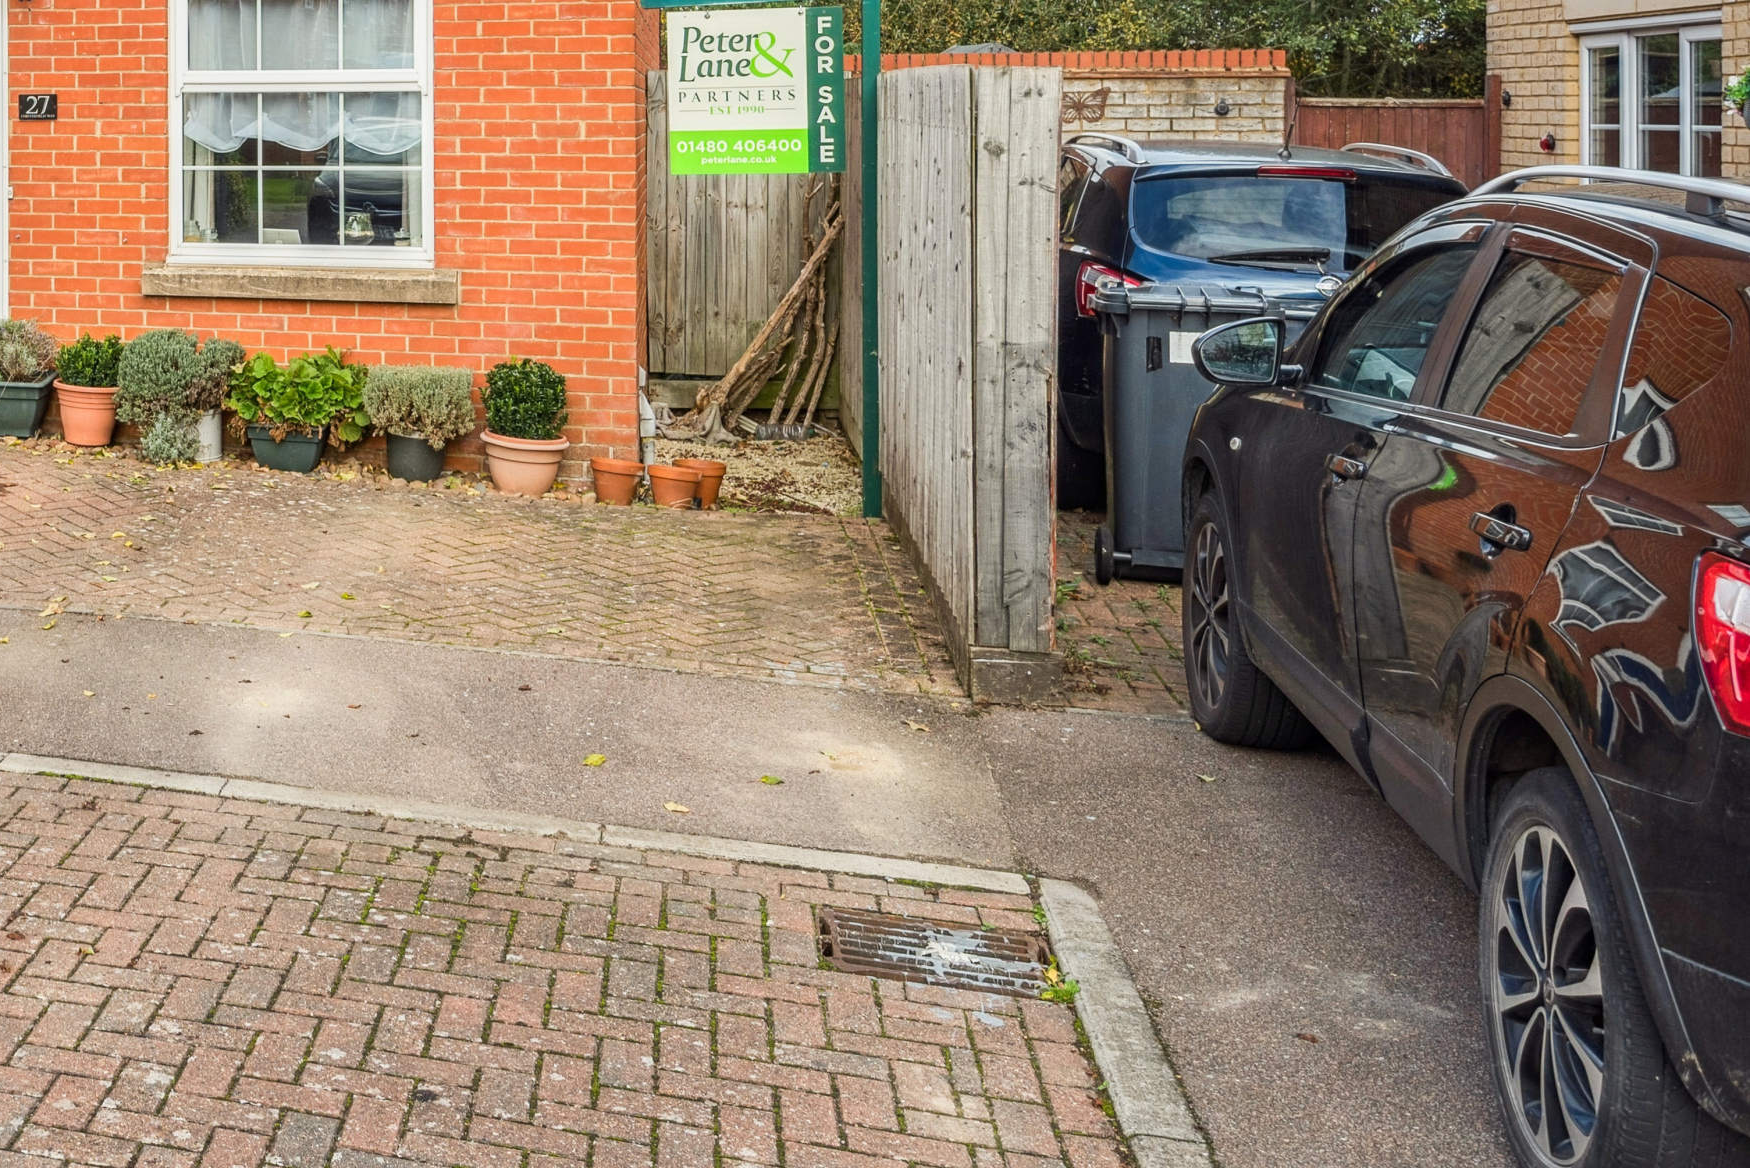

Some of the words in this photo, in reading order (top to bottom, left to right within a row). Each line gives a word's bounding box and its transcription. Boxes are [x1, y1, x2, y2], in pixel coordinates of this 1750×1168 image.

[681, 26, 759, 54] Peter
[814, 16, 835, 74] FOR
[678, 55, 751, 83] Lane
[749, 31, 797, 79] &
[25, 95, 50, 115] 27
[678, 89, 796, 103] PARTNERS
[709, 106, 733, 115] EST
[737, 105, 765, 115] 1990
[816, 85, 837, 163] SALE
[676, 140, 728, 153] 01480
[732, 139, 802, 152] 406400
[701, 155, 777, 166] peterlane.co.uk
